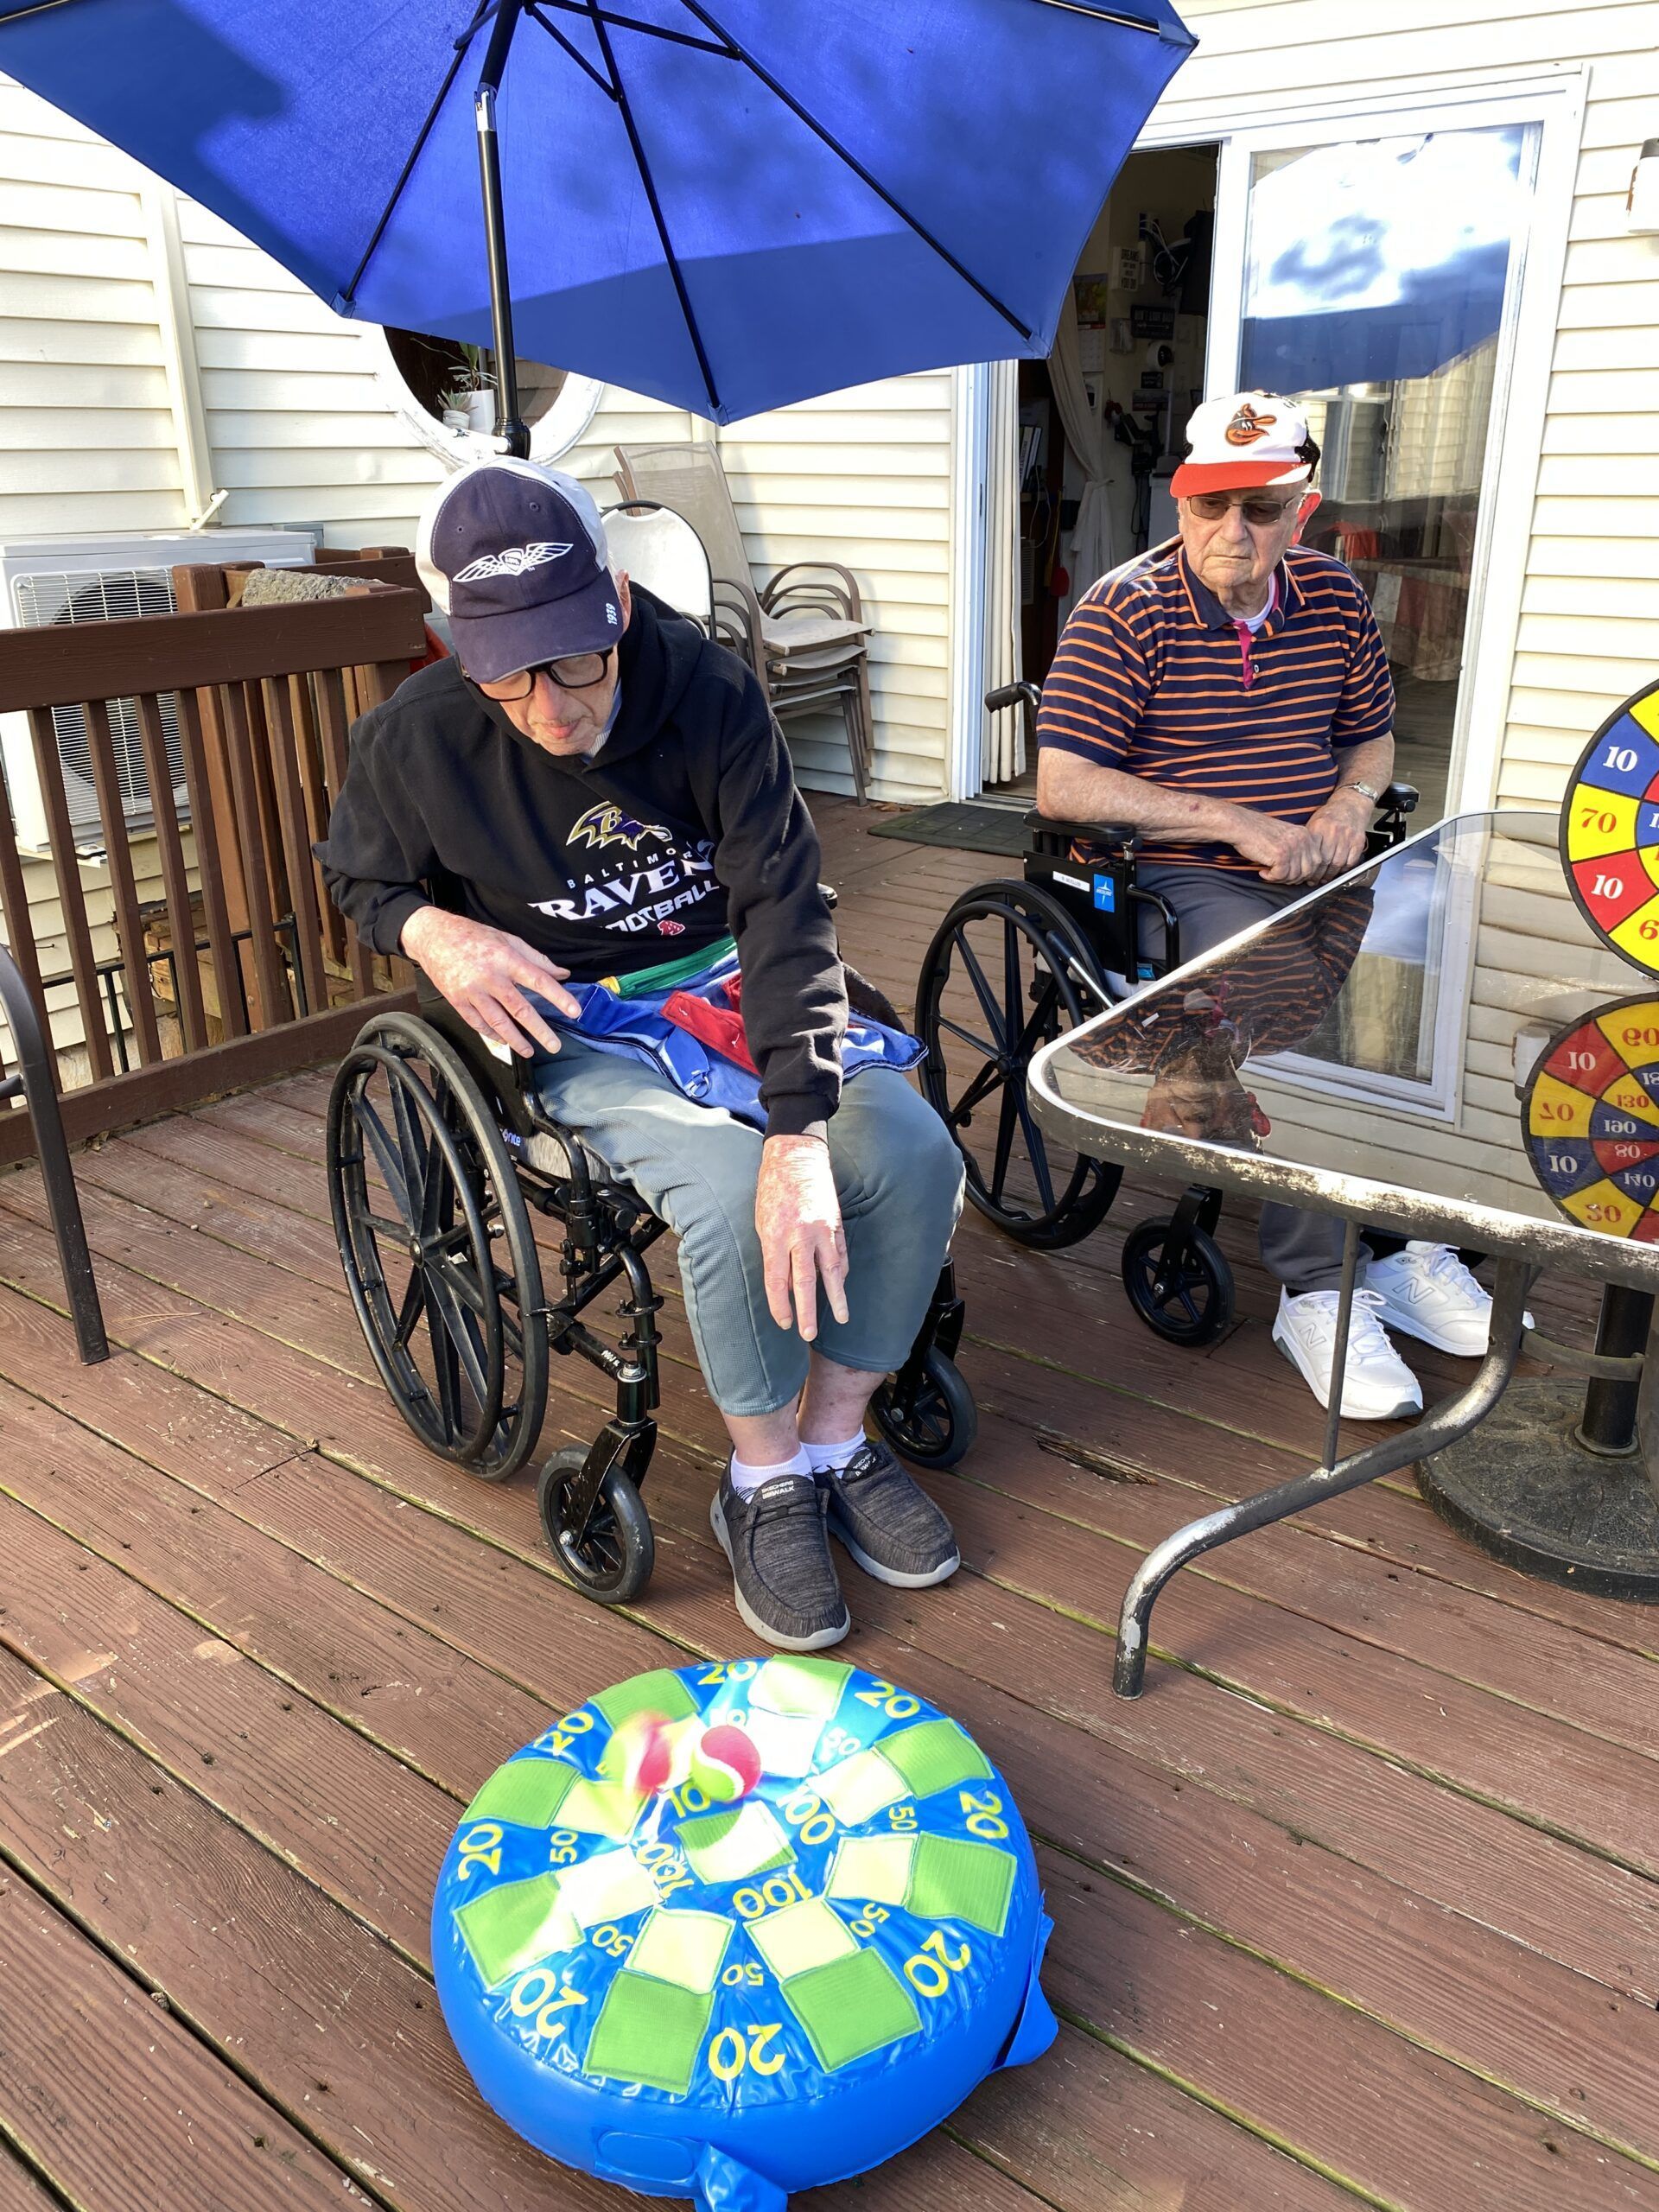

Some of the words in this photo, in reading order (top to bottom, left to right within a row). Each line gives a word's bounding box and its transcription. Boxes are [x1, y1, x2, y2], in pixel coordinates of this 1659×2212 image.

[606, 603, 618, 625] 1939
[1603, 746, 1637, 772] 10
[601, 809, 623, 834] B
[1580, 808, 1617, 834] 70
[527, 839, 715, 921] RAVEN
[567, 848, 693, 889] BALTIMOR
[1591, 874, 1624, 899] 10
[605, 880, 720, 932] OOTBALL
[1639, 919, 1659, 940] 6
[697, 1661, 757, 1685] 20
[855, 1681, 920, 1719] 20
[533, 1712, 594, 1756] 20
[667, 1780, 711, 1818] 10
[959, 1790, 1008, 1839] 20
[888, 1806, 918, 1831] 50
[457, 1823, 504, 1881] 20
[550, 1830, 579, 1864] 50
[733, 1866, 813, 1918] 100
[849, 1903, 891, 1938] 50
[592, 1925, 633, 1957] 50
[721, 1962, 763, 1986] 50
[903, 1929, 971, 1998] 20
[510, 1968, 588, 2038] 20
[708, 2023, 785, 2081] 20
